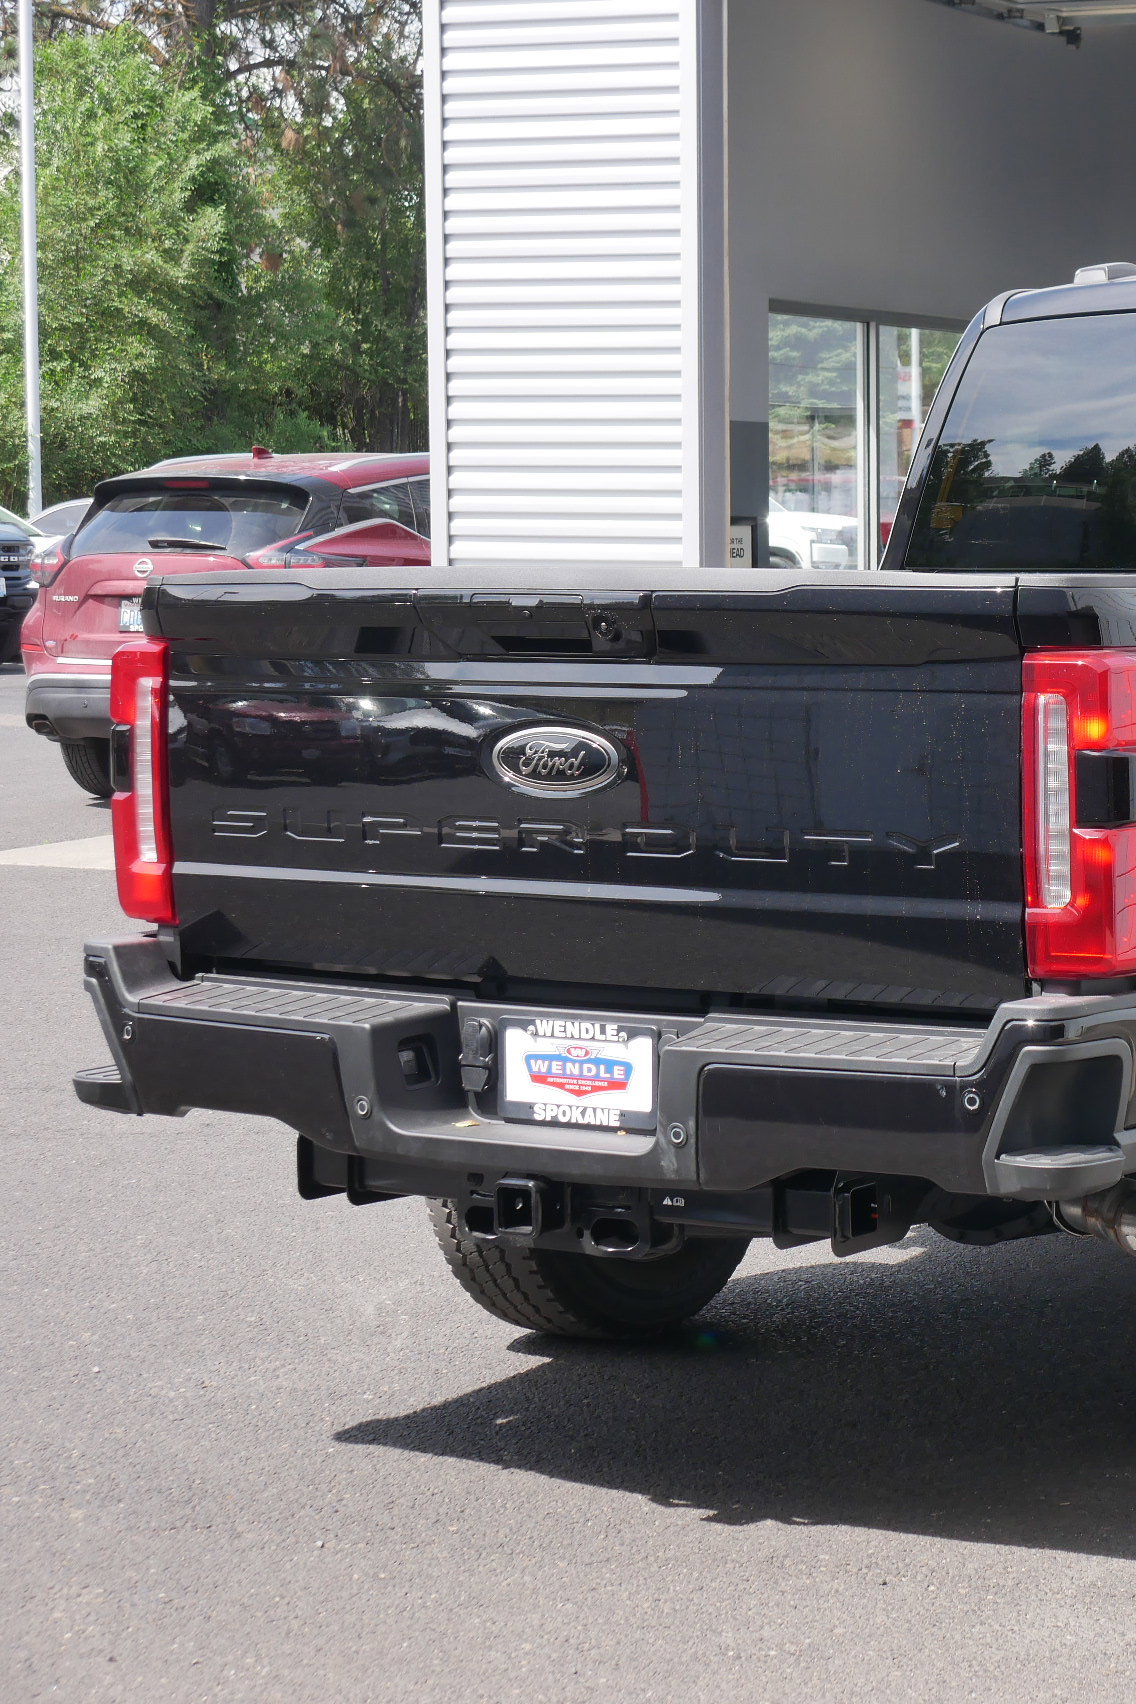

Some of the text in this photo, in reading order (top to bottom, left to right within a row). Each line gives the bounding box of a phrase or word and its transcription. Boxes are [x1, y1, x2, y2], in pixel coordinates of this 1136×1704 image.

[520, 740, 586, 776] Ford
[212, 808, 961, 870] SUPER DUTY
[535, 1019, 619, 1040] WENDLE
[530, 1059, 625, 1078] WENDLE
[533, 1103, 620, 1126] SPOKANE
